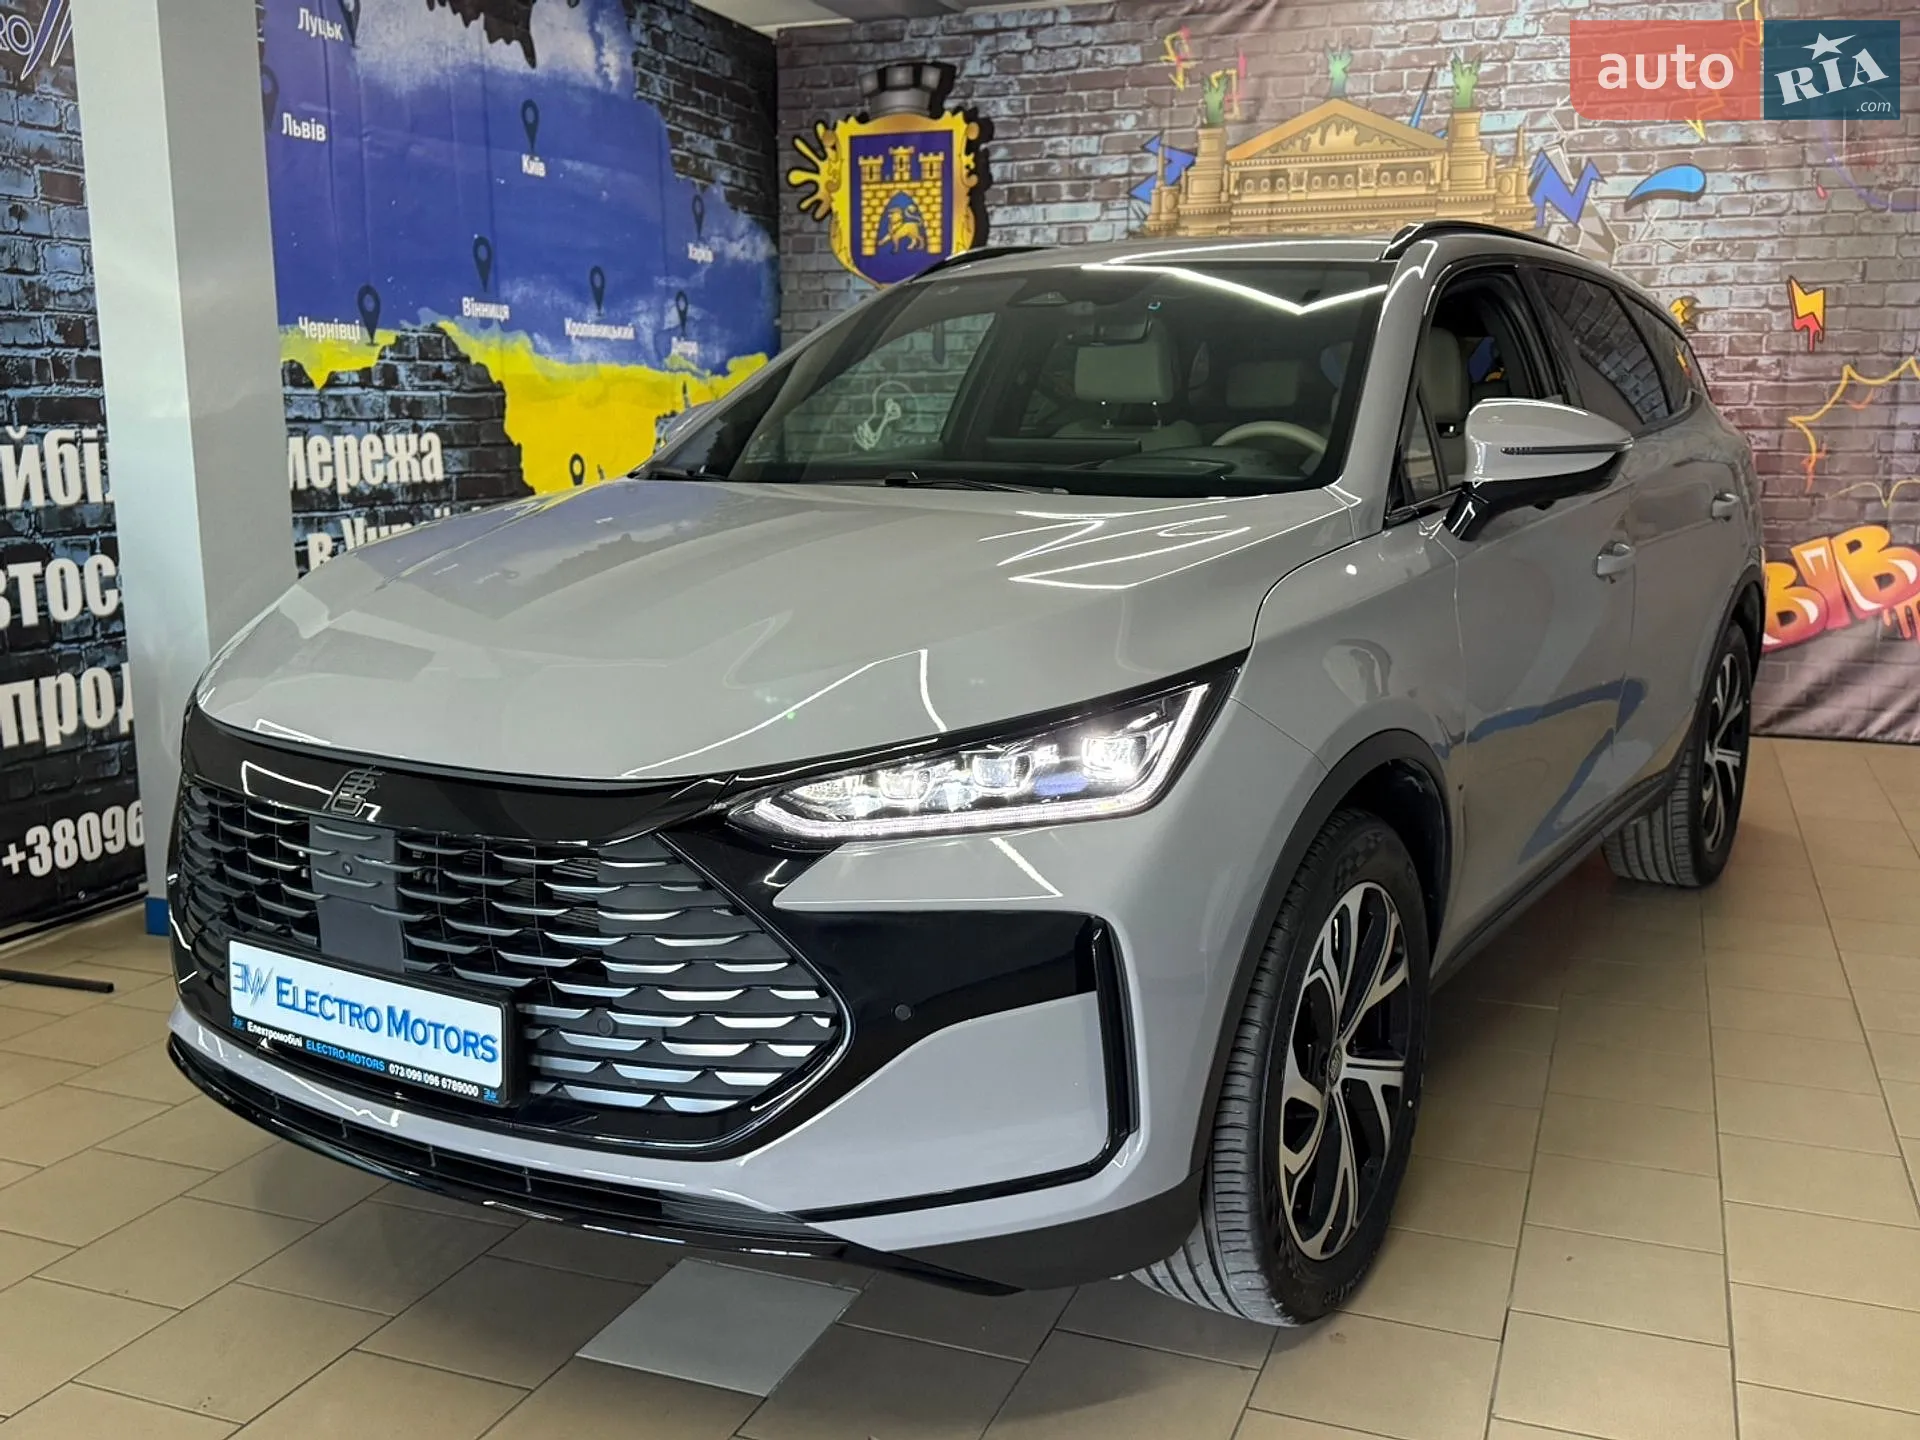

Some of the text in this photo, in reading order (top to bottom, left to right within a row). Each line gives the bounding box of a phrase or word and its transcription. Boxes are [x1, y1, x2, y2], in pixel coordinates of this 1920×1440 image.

[298, 7, 344, 41] Луцьк
[281, 111, 327, 142] Львів
[462, 296, 510, 322] Вінниця
[298, 316, 361, 342] Чернівці
[276, 975, 384, 1034] ELECTRO
[387, 1004, 499, 1063] MOTORS
[306, 1040, 385, 1072] ELECTRO-MOTORS
